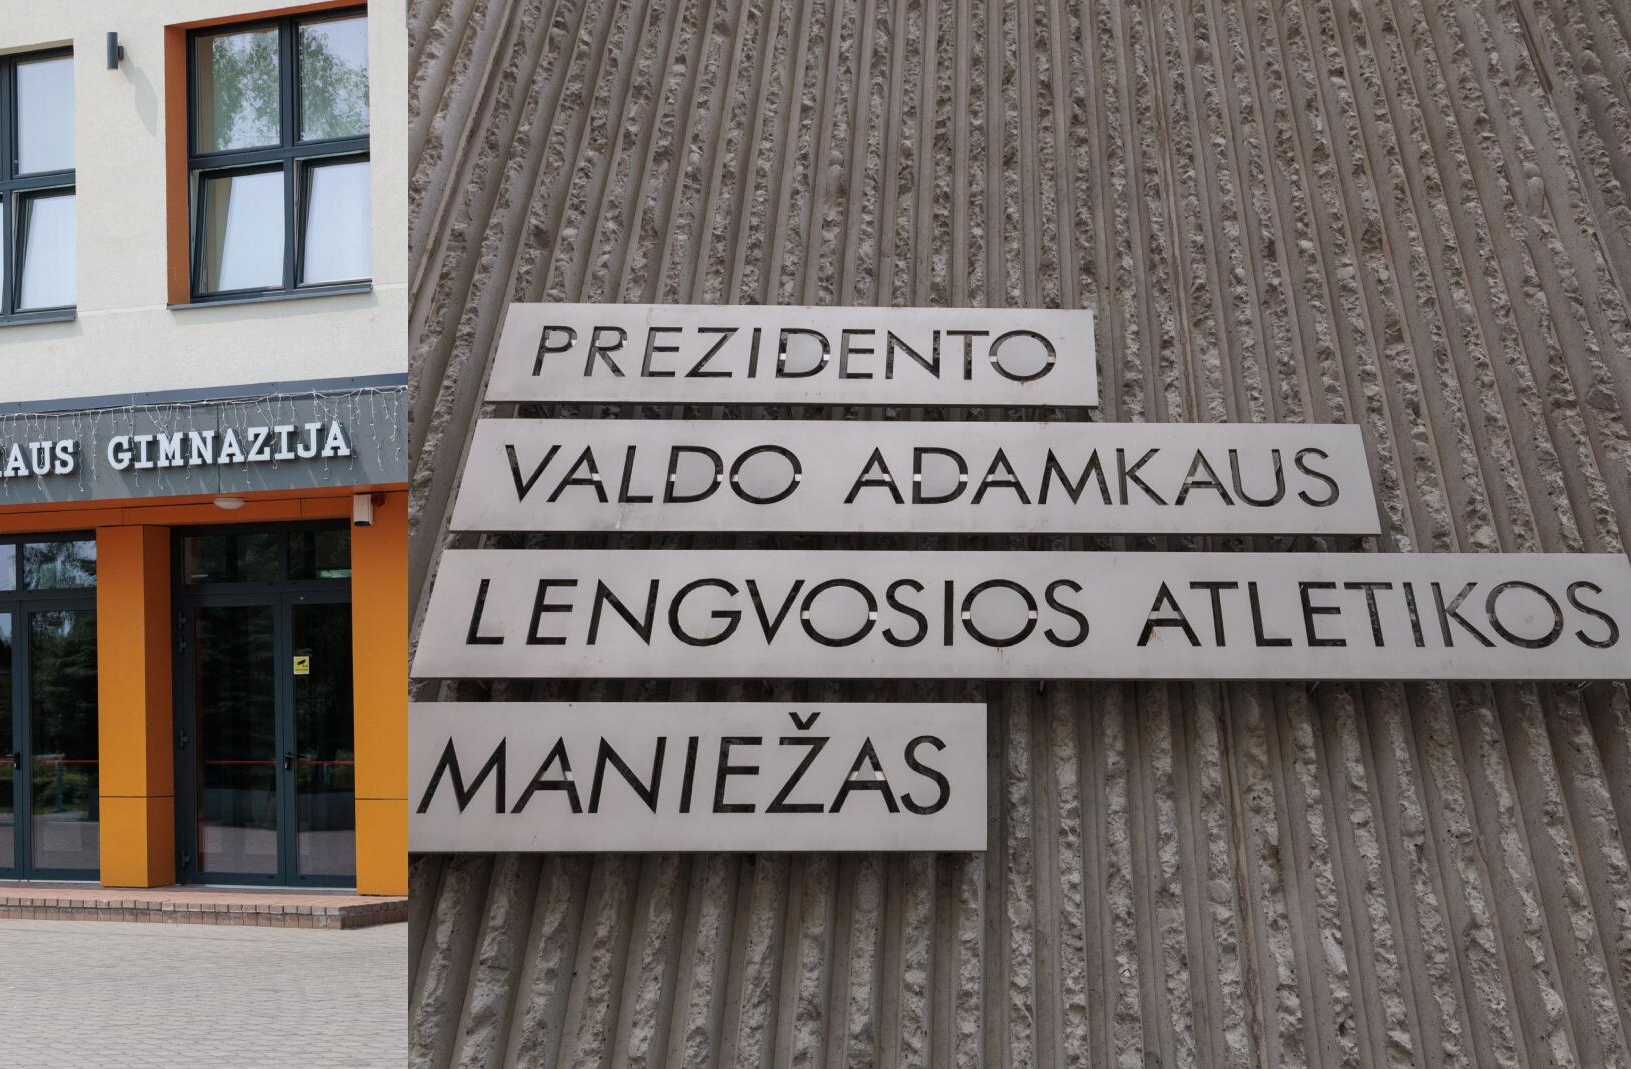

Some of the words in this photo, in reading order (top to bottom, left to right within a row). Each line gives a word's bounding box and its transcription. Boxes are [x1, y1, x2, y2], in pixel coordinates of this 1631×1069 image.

[531, 325, 1057, 382] PREZIDENTO
[106, 421, 351, 470] GIMNAZIJA
[504, 444, 802, 505] VALDO
[842, 446, 1341, 507] ADAMKAUS
[465, 578, 1090, 648] LENGVOSIOS
[1135, 579, 1620, 650] ATLETIKOS
[415, 711, 951, 815] MANIEŽAS
